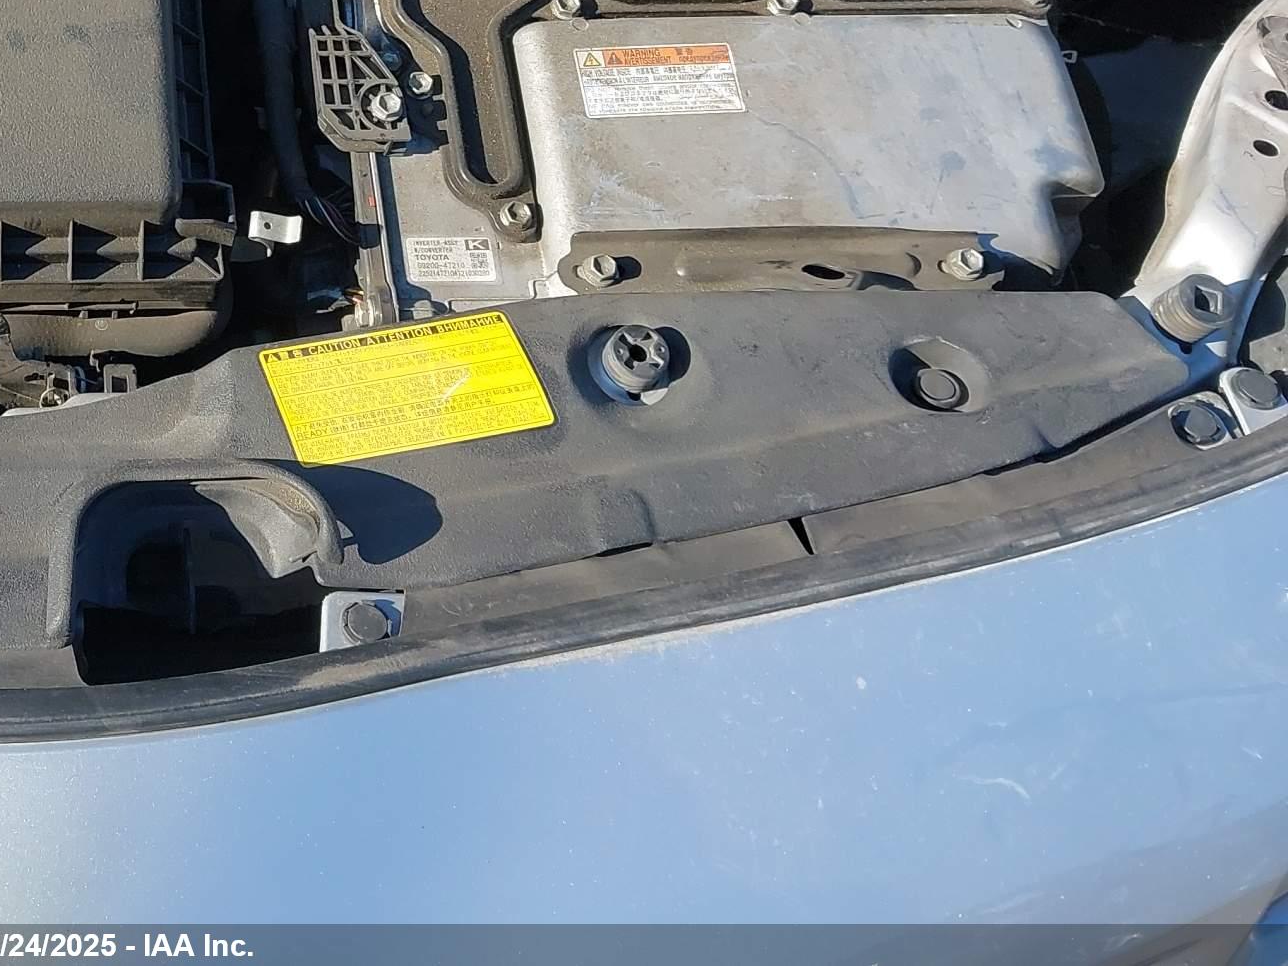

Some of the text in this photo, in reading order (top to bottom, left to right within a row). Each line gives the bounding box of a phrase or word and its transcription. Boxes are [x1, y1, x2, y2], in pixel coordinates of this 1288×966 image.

[623, 49, 661, 58] WARNING
[624, 56, 672, 65] AVERTISSEMENT
[309, 338, 361, 355] CAUTION
[366, 325, 433, 346] ATTENTION
[437, 314, 503, 334] ВНИМАНИЕ
